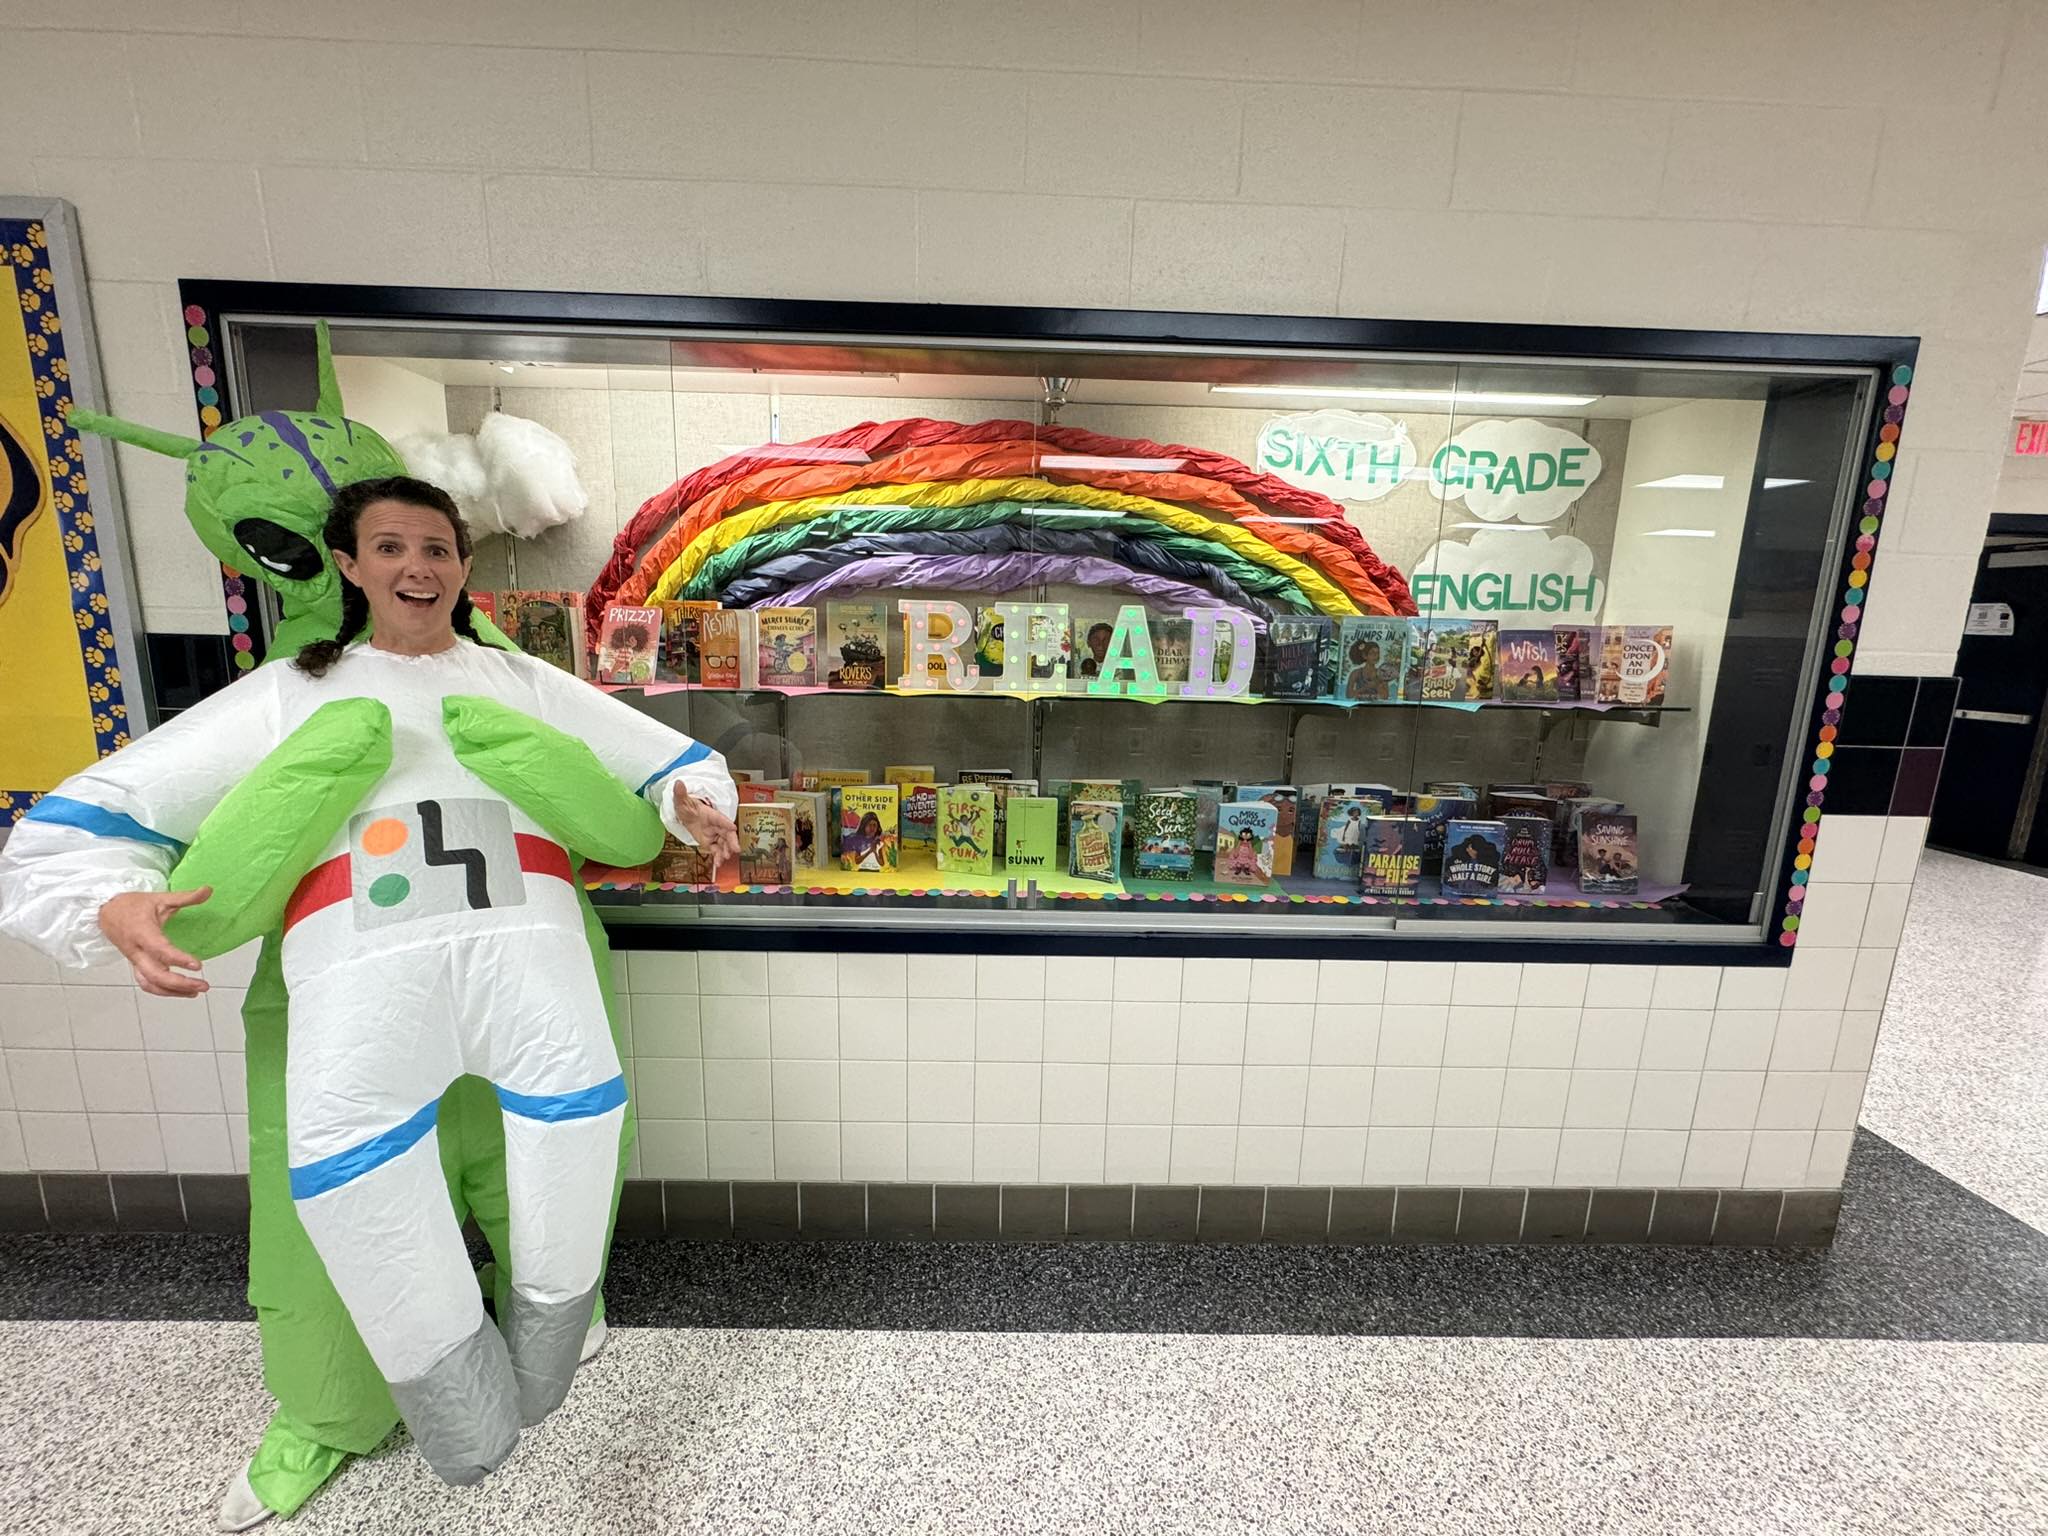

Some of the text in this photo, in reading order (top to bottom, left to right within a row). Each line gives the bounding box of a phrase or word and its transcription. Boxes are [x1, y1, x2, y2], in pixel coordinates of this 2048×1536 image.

[2015, 422, 2048, 456] EXI
[1264, 428, 1590, 495] SIXTH GRADE
[1411, 572, 1596, 612] ENGLISH
[608, 607, 656, 625] FRIZZY
[674, 606, 702, 624] THIRS
[1351, 630, 1383, 641] JUMPS
[898, 599, 1256, 697] READ
[1511, 640, 1548, 663] Wish
[1623, 644, 1650, 653] ONCE
[1628, 660, 1642, 668] AN
[839, 666, 872, 681] ROVER'S
[1626, 667, 1643, 676] EID
[1422, 687, 1451, 699] Seen
[845, 795, 872, 803] OTHER
[906, 800, 936, 811] INVENTE
[948, 803, 986, 815] FIRST
[1149, 801, 1174, 818] Seed
[1239, 810, 1259, 819] MISS
[1155, 817, 1187, 836] Sun
[1228, 815, 1266, 827] QUINCES
[1596, 824, 1625, 835] SAVING
[949, 847, 978, 861] PUNK
[1008, 856, 1045, 865] SUNNY
[1449, 863, 1497, 876] WHOLE STORY
[1452, 872, 1469, 881] HALF
[1476, 873, 1493, 884] GIRL
